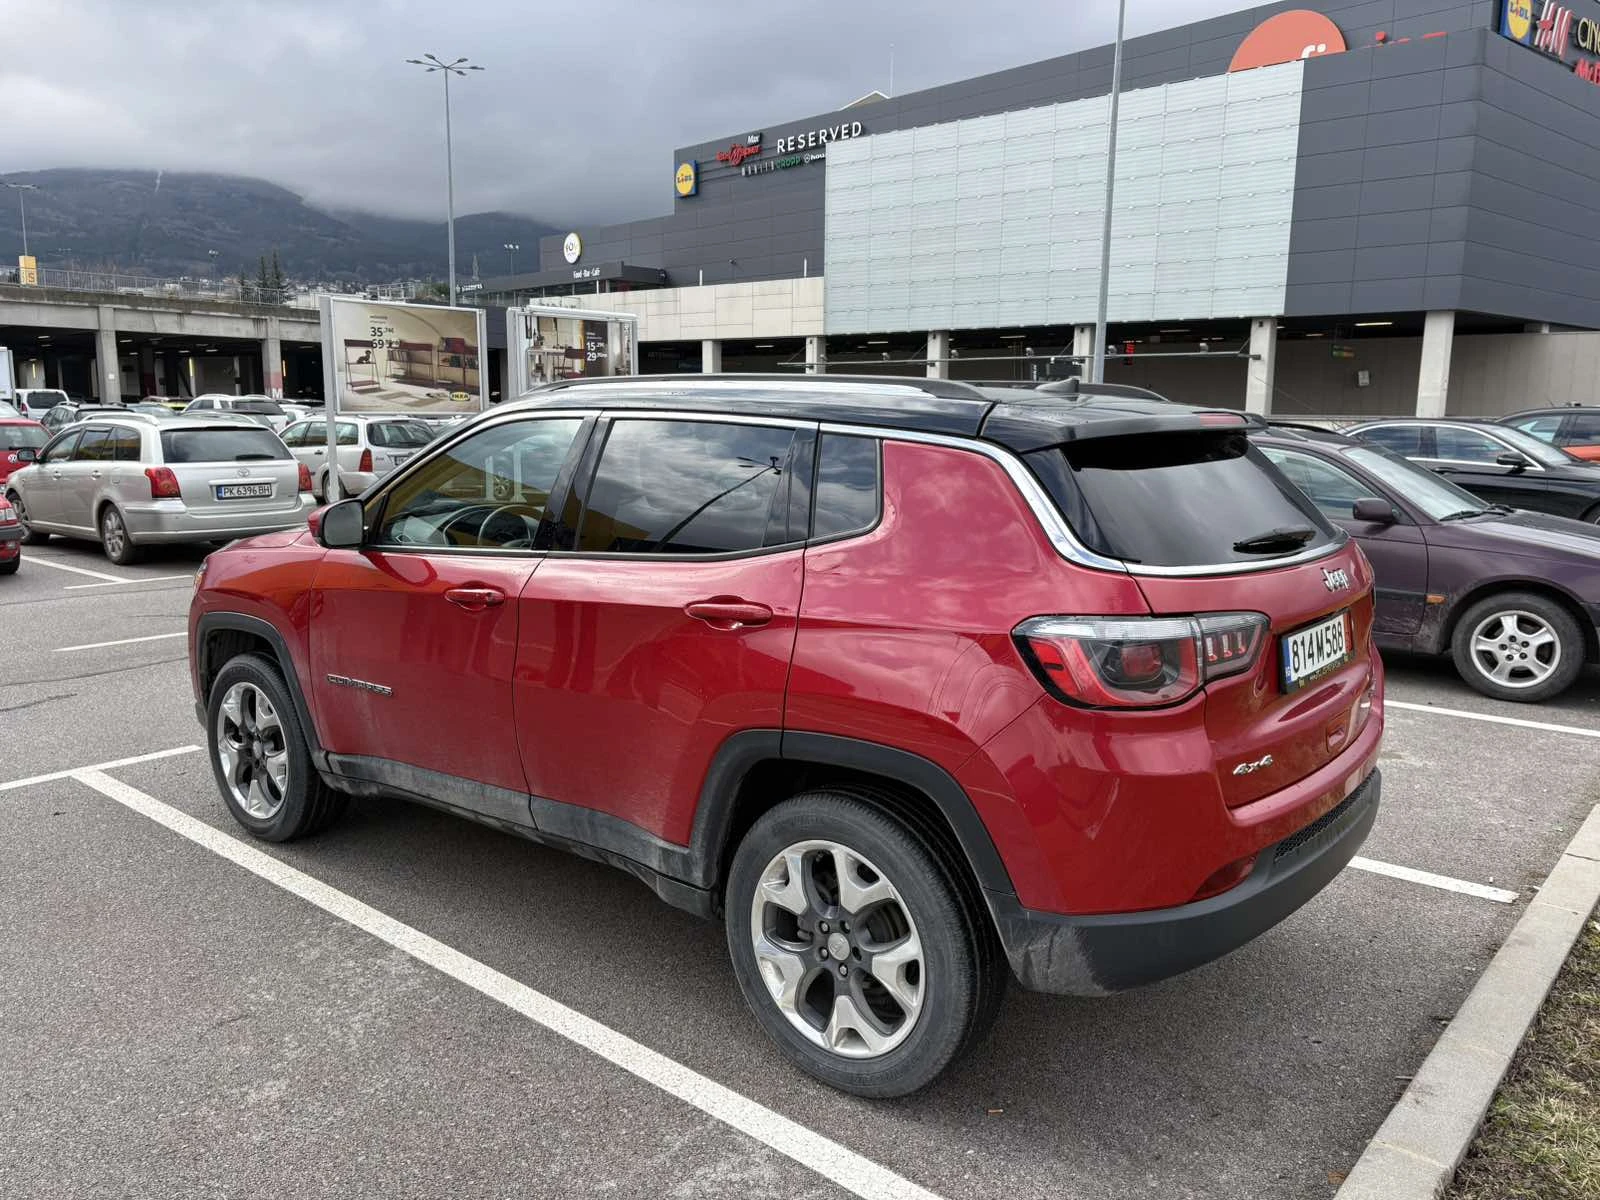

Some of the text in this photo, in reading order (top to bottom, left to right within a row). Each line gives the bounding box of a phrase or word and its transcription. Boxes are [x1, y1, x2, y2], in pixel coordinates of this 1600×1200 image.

[777, 121, 862, 154] RESERVED
[370, 326, 383, 337] 35
[586, 341, 596, 351] 15
[586, 351, 597, 362] 29
[223, 486, 235, 497] PK
[236, 484, 258, 496] 6396
[1322, 568, 1349, 592] Jeep
[1232, 754, 1274, 776] 4x4
